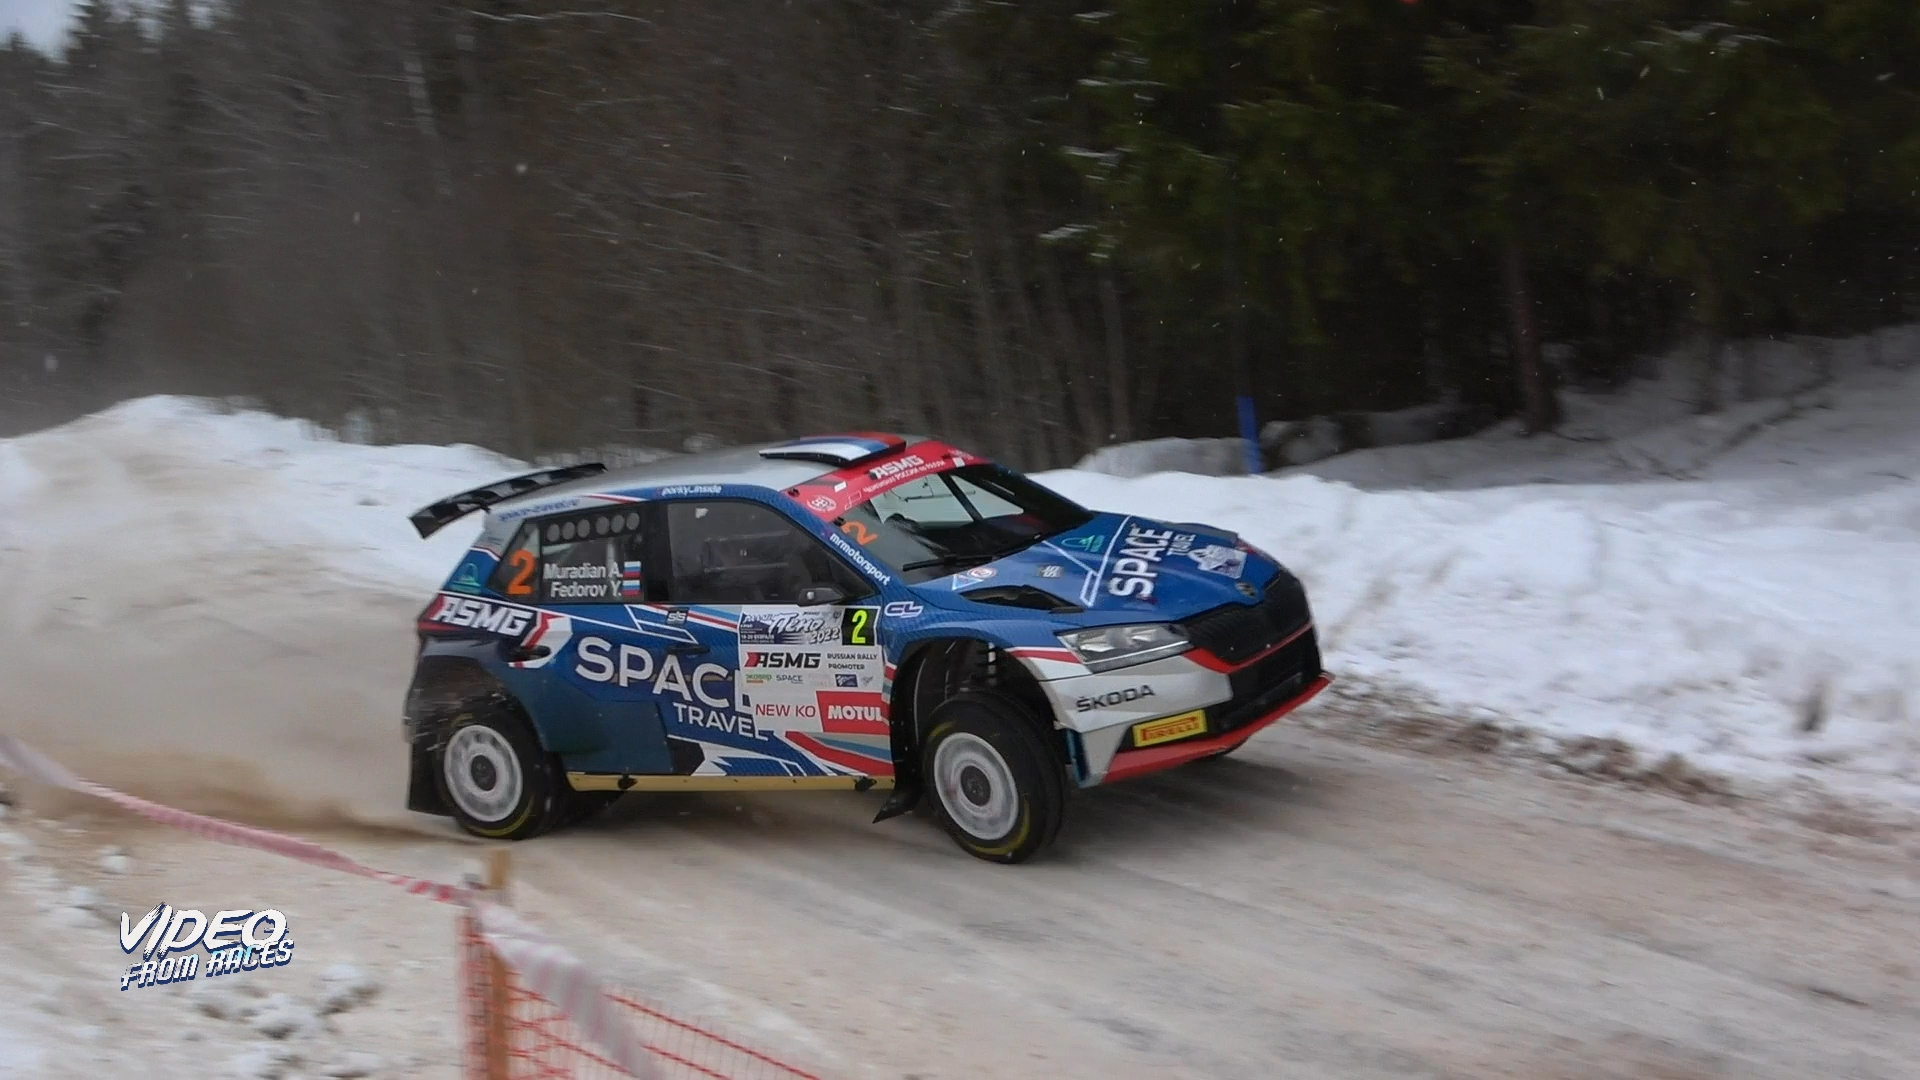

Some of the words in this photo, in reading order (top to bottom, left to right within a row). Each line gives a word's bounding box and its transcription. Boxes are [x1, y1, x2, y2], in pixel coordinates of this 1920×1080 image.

[873, 454, 924, 479] ASMG
[841, 521, 878, 546] 2
[506, 548, 536, 596] 2
[543, 561, 606, 580] Muradian
[608, 560, 623, 578] A.
[829, 533, 891, 586] mrmotorsport
[1108, 528, 1173, 597] SPACE
[550, 581, 607, 598] Fedorov
[610, 580, 622, 597] Y.
[430, 596, 534, 637] ASMG
[851, 609, 868, 644] 2
[808, 627, 840, 645] 2022
[745, 651, 822, 669] ASMG
[776, 674, 803, 682] SPACE
[755, 703, 790, 717] NEW
[796, 705, 816, 718] KO
[1076, 684, 1155, 713] ŠKODA
[827, 705, 884, 721] MOTUL
[1142, 716, 1198, 742] PIRELLI
